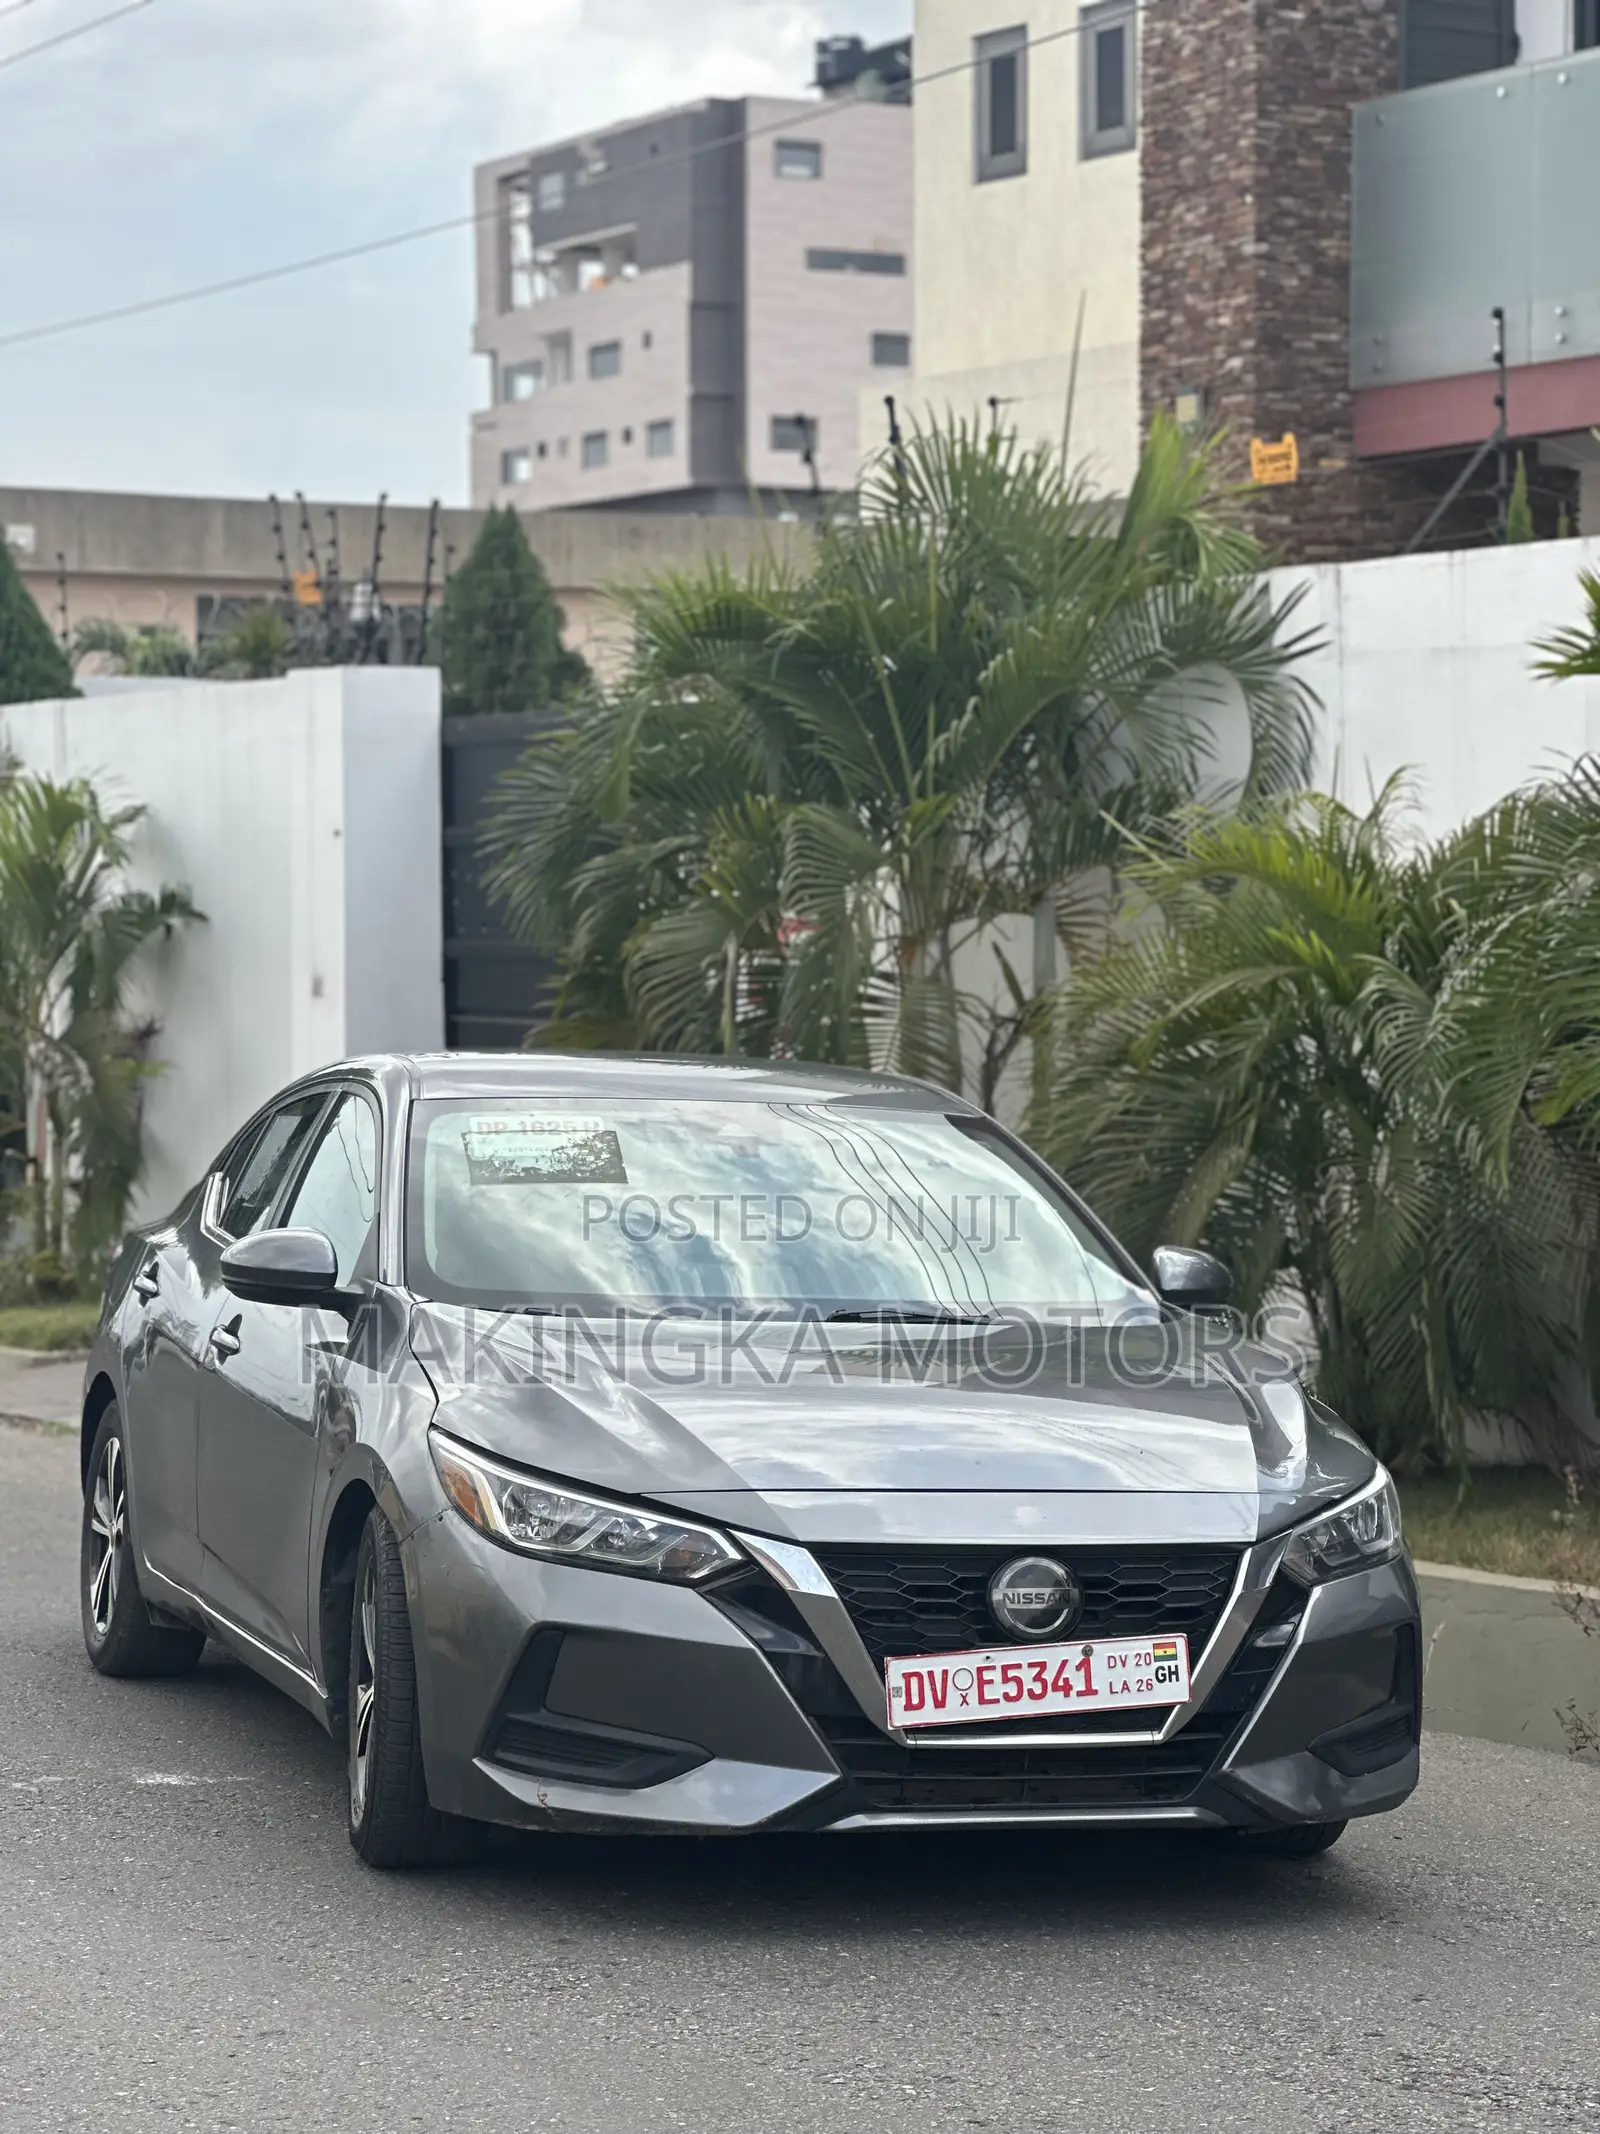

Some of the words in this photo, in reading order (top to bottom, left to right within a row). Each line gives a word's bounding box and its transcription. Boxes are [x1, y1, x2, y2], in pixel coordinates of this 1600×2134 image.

[476, 1121, 508, 1136] DP
[1002, 1592, 1071, 1605] NISSAN
[1107, 1654, 1127, 1669] DV
[1135, 1652, 1152, 1667] 20
[1155, 1665, 1180, 1684] GH
[902, 1669, 949, 1711] DV
[976, 1656, 1099, 1706] E5341
[1109, 1680, 1131, 1695] LA
[1136, 1678, 1153, 1692] 26
